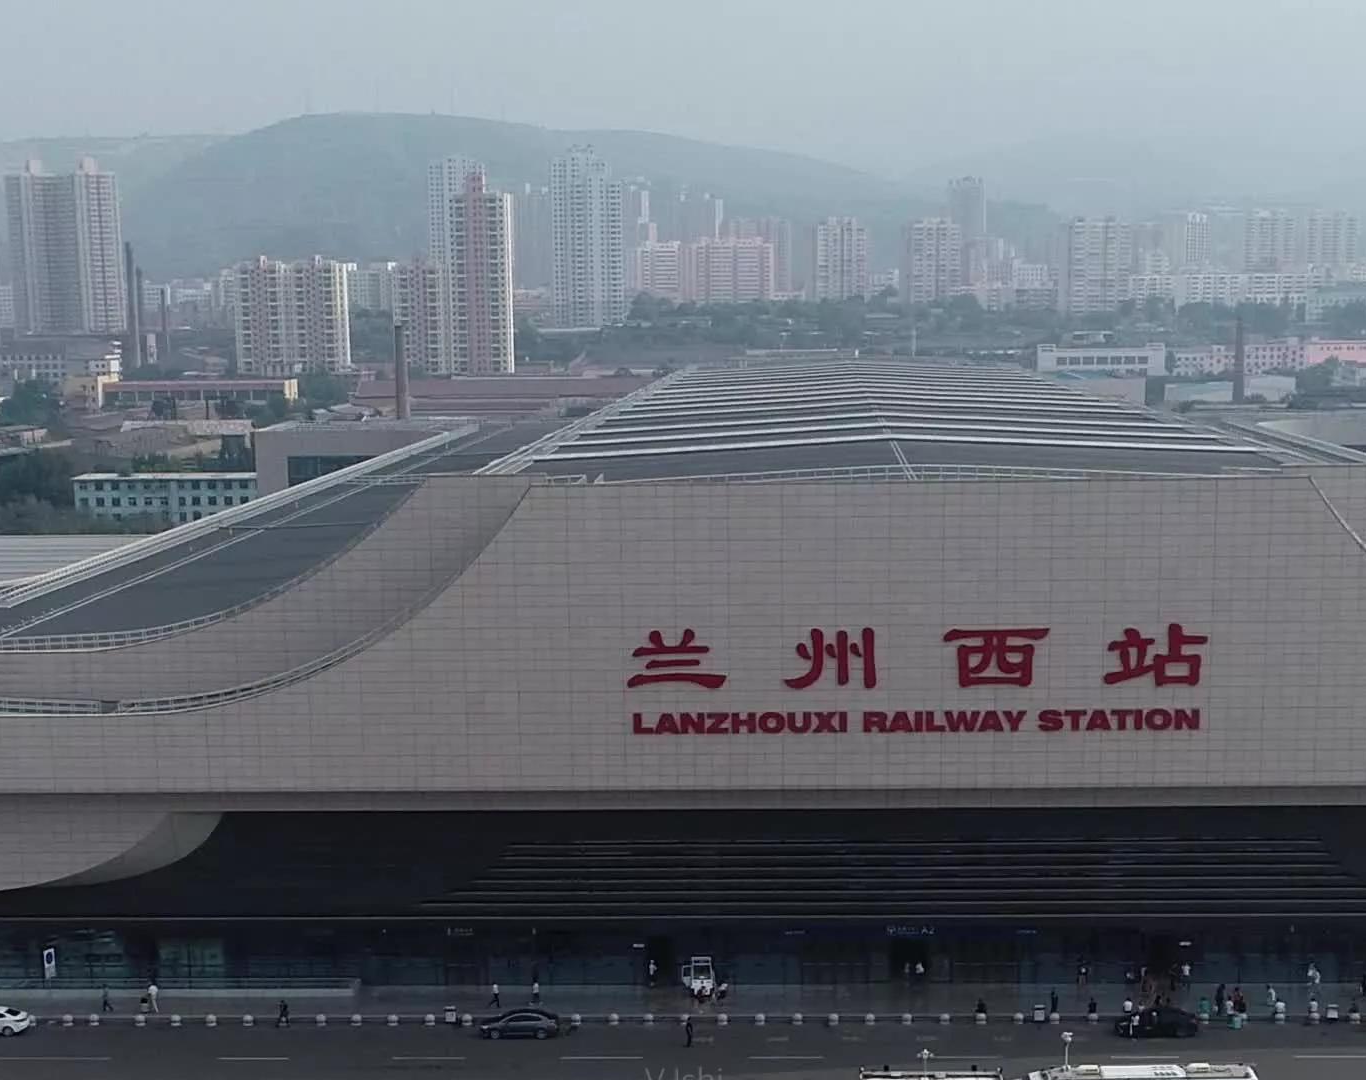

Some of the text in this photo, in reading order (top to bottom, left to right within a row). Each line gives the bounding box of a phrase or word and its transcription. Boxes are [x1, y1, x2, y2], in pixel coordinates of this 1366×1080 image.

[627, 623, 1208, 689] 兰州西站
[632, 708, 1200, 735] LANZHOUXI RAILWAY STATION
